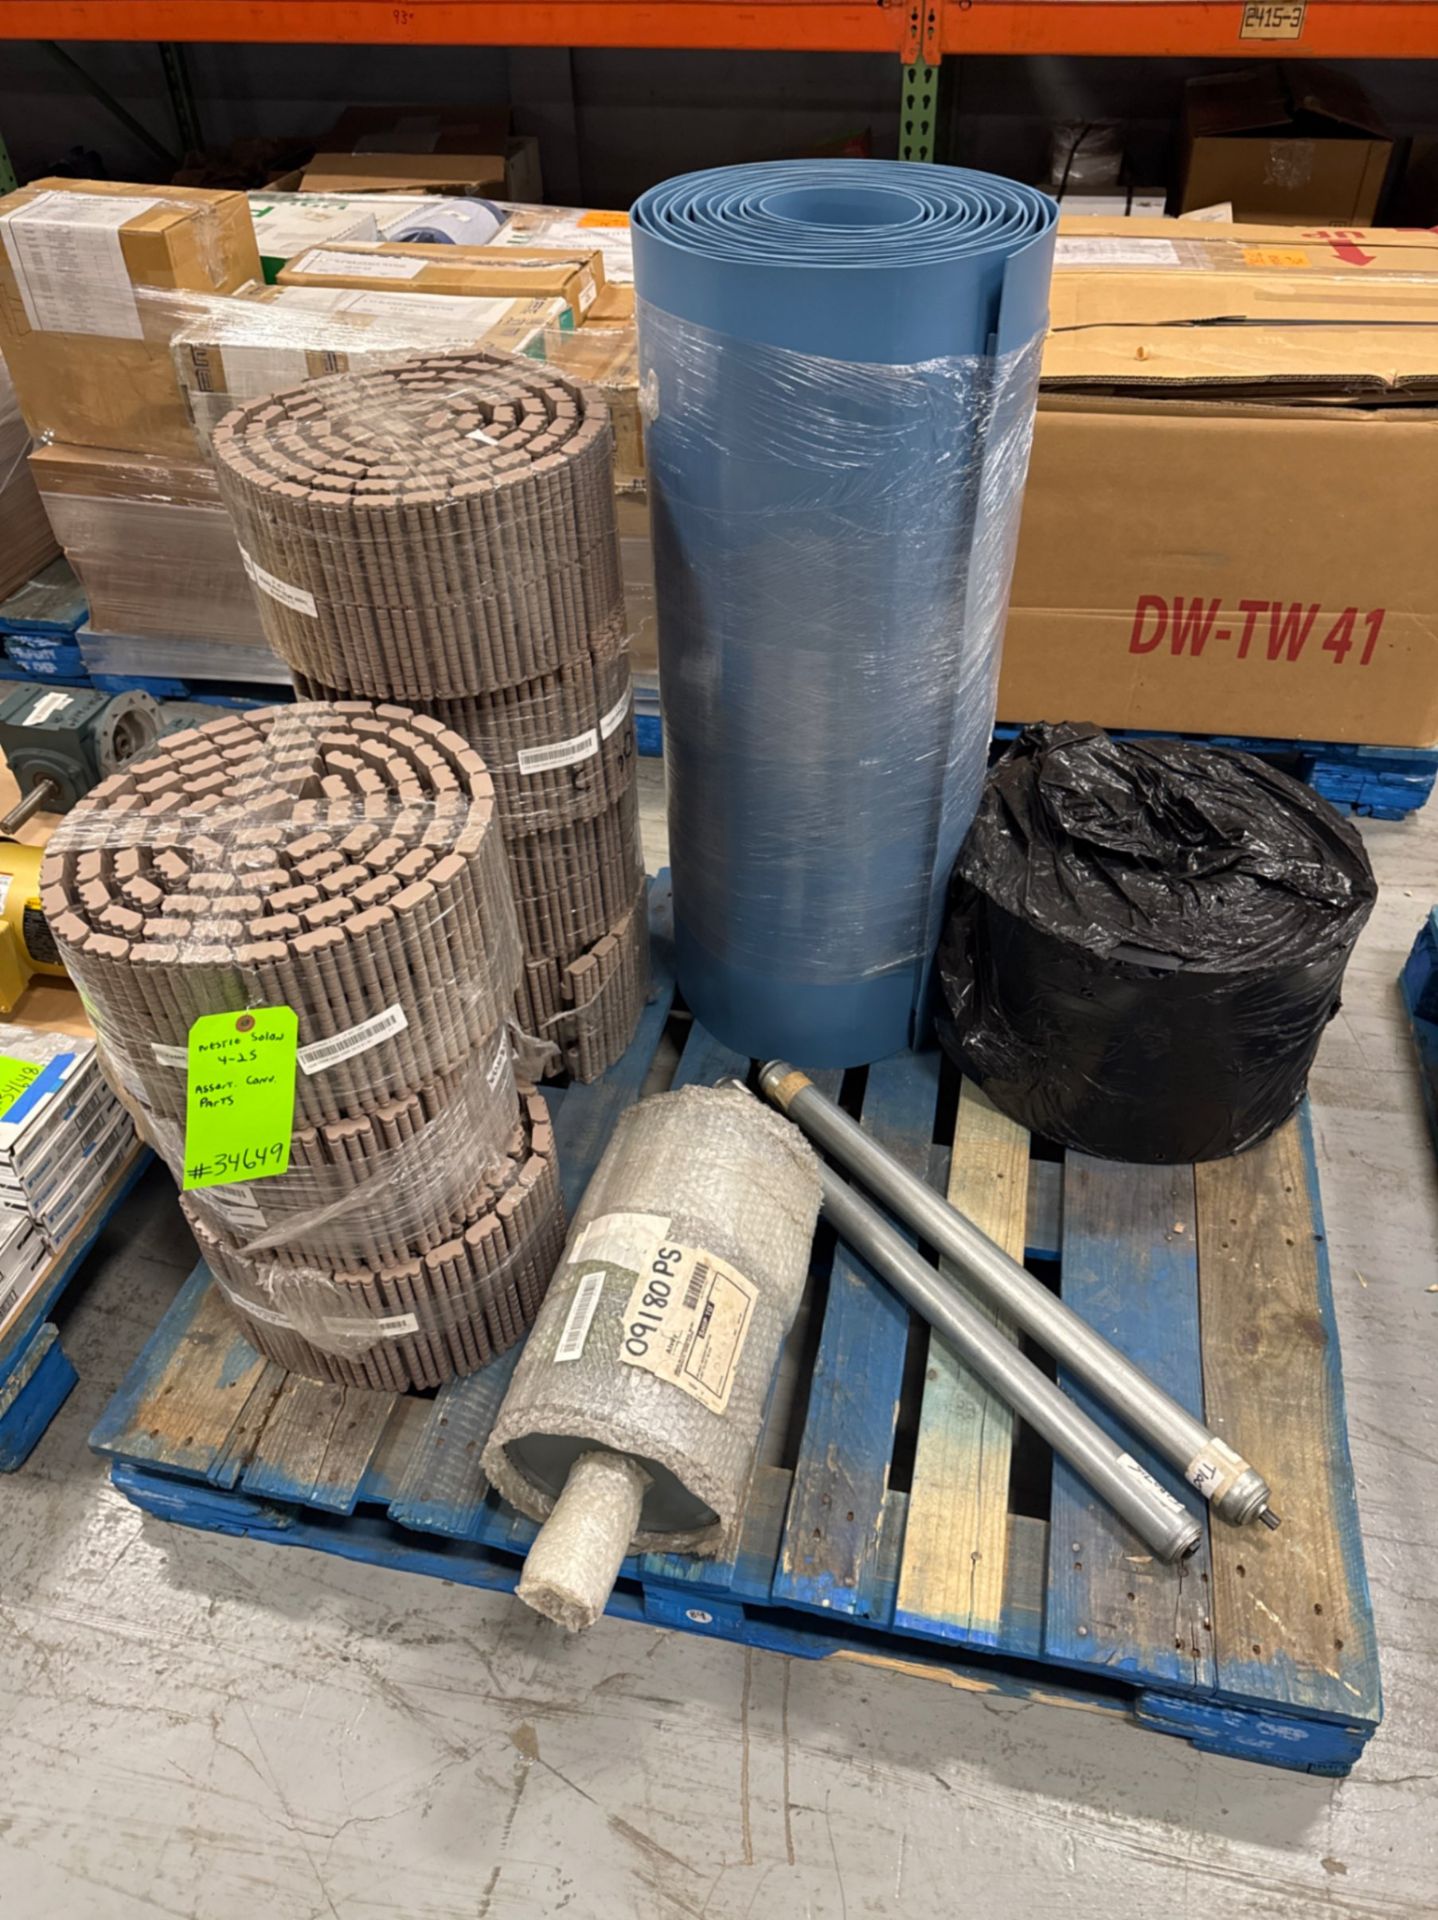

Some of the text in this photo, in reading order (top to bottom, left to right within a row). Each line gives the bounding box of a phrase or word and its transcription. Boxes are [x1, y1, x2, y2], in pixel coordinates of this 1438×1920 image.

[1245, 7, 1302, 28] 2415-3
[1300, 230, 1366, 239] UP
[1128, 594, 1386, 666] DW-TW 41
[217, 1049, 257, 1065] 4-25
[187, 1142, 284, 1179] #34649
